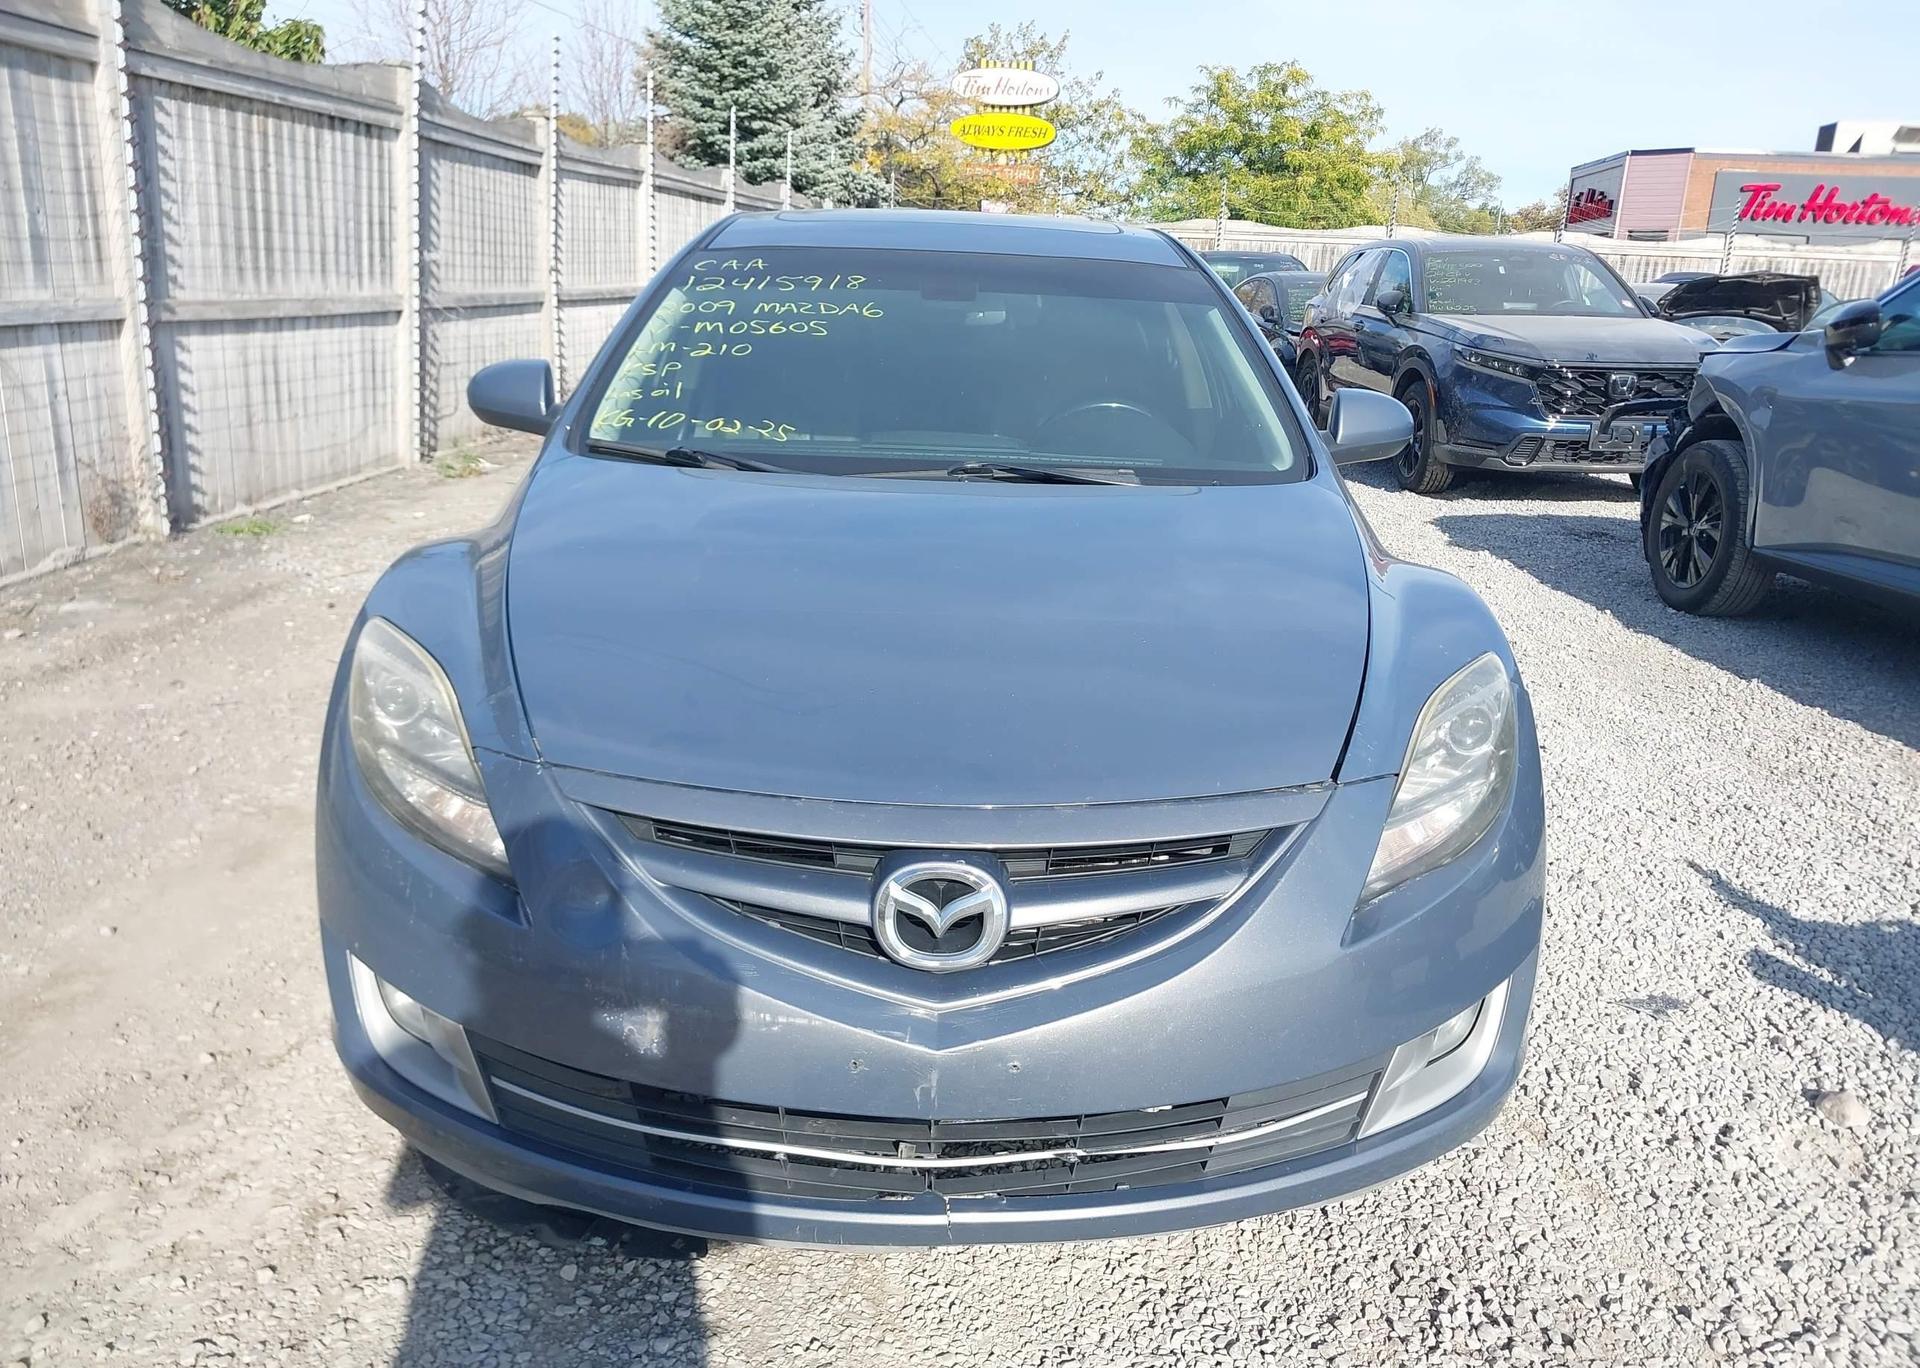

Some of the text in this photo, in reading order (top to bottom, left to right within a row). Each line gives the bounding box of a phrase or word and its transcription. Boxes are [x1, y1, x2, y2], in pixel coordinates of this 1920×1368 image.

[959, 123, 1050, 140] ALWAYS FRESH
[1738, 183, 1920, 226] Tim Horton
[693, 257, 769, 273] CAA
[682, 274, 868, 292] 12415918
[752, 301, 885, 319] MAZDA6
[651, 381, 683, 400] oil
